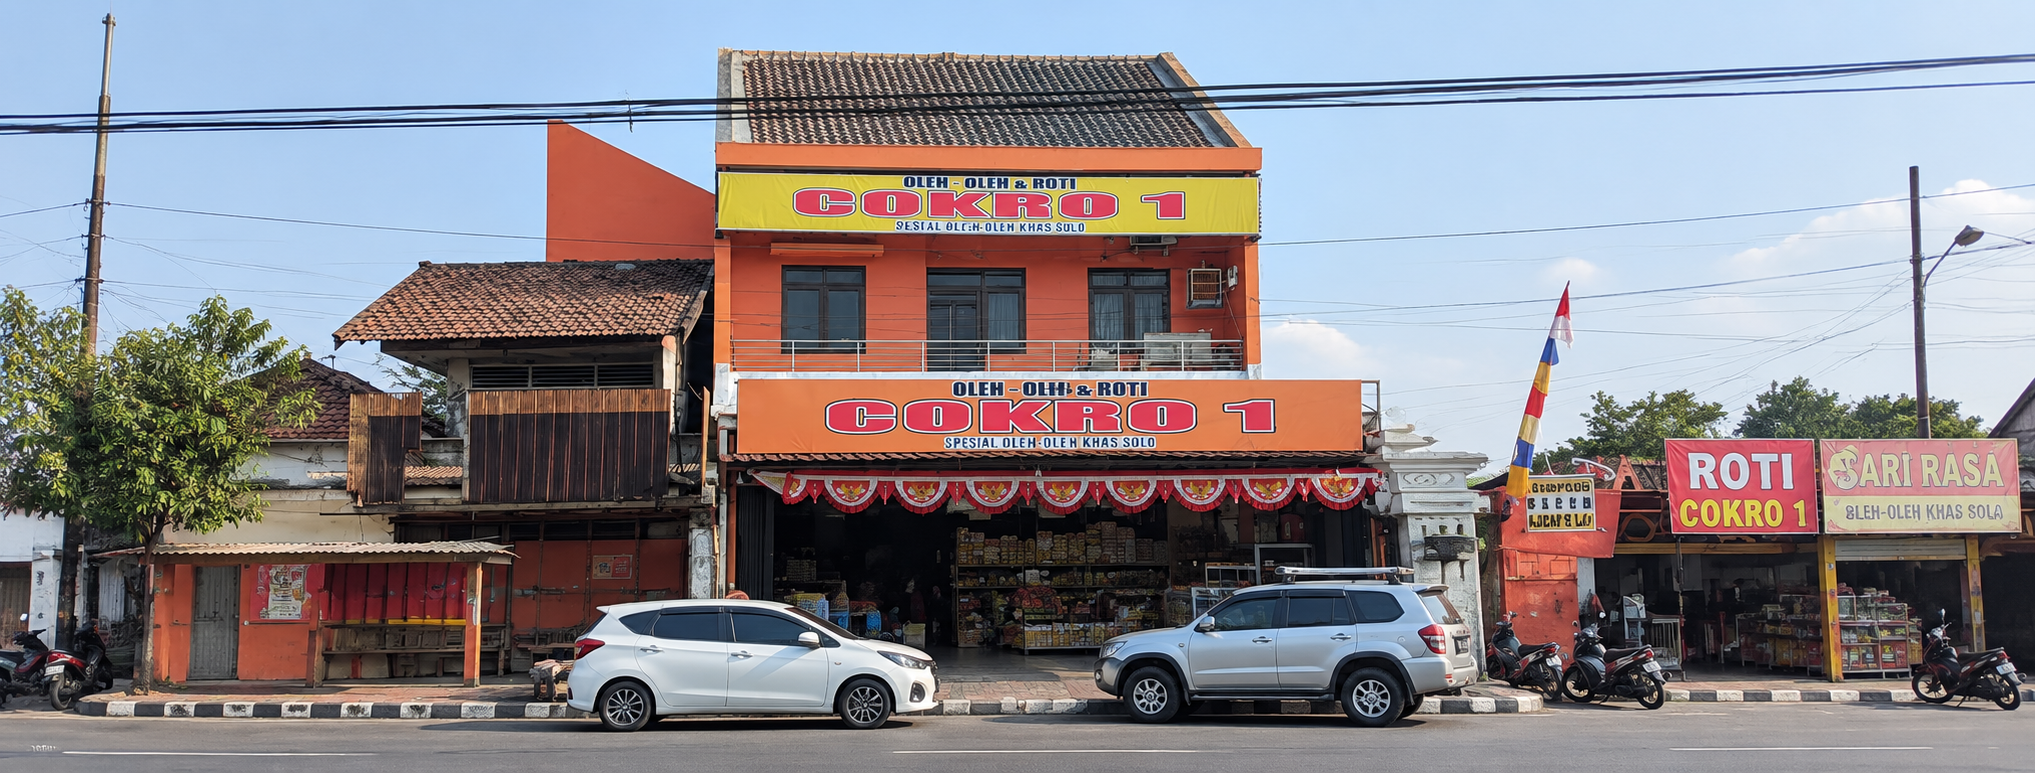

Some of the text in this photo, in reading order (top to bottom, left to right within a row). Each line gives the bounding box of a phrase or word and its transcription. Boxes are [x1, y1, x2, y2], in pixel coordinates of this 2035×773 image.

[903, 176, 948, 189] OLEH
[965, 177, 1009, 189] OLEH
[1014, 179, 1028, 189] &
[1032, 177, 1076, 190] ROTI
[792, 187, 1186, 221] COKRO 1
[1019, 222, 1052, 233] KHAS
[1056, 223, 1085, 233] SOLO
[953, 381, 1004, 397] OLEH
[1077, 384, 1093, 397] &
[1097, 381, 1148, 397] ROTI
[825, 398, 1276, 434] COKRO 1
[944, 436, 1155, 449] SPESIAL OLEH-OLEH KHAS SOLO
[1687, 452, 1794, 490] ROTI
[1920, 451, 2005, 487] RASA
[1679, 498, 1806, 528] COKRO 1
[1926, 503, 1963, 520] KHAS
